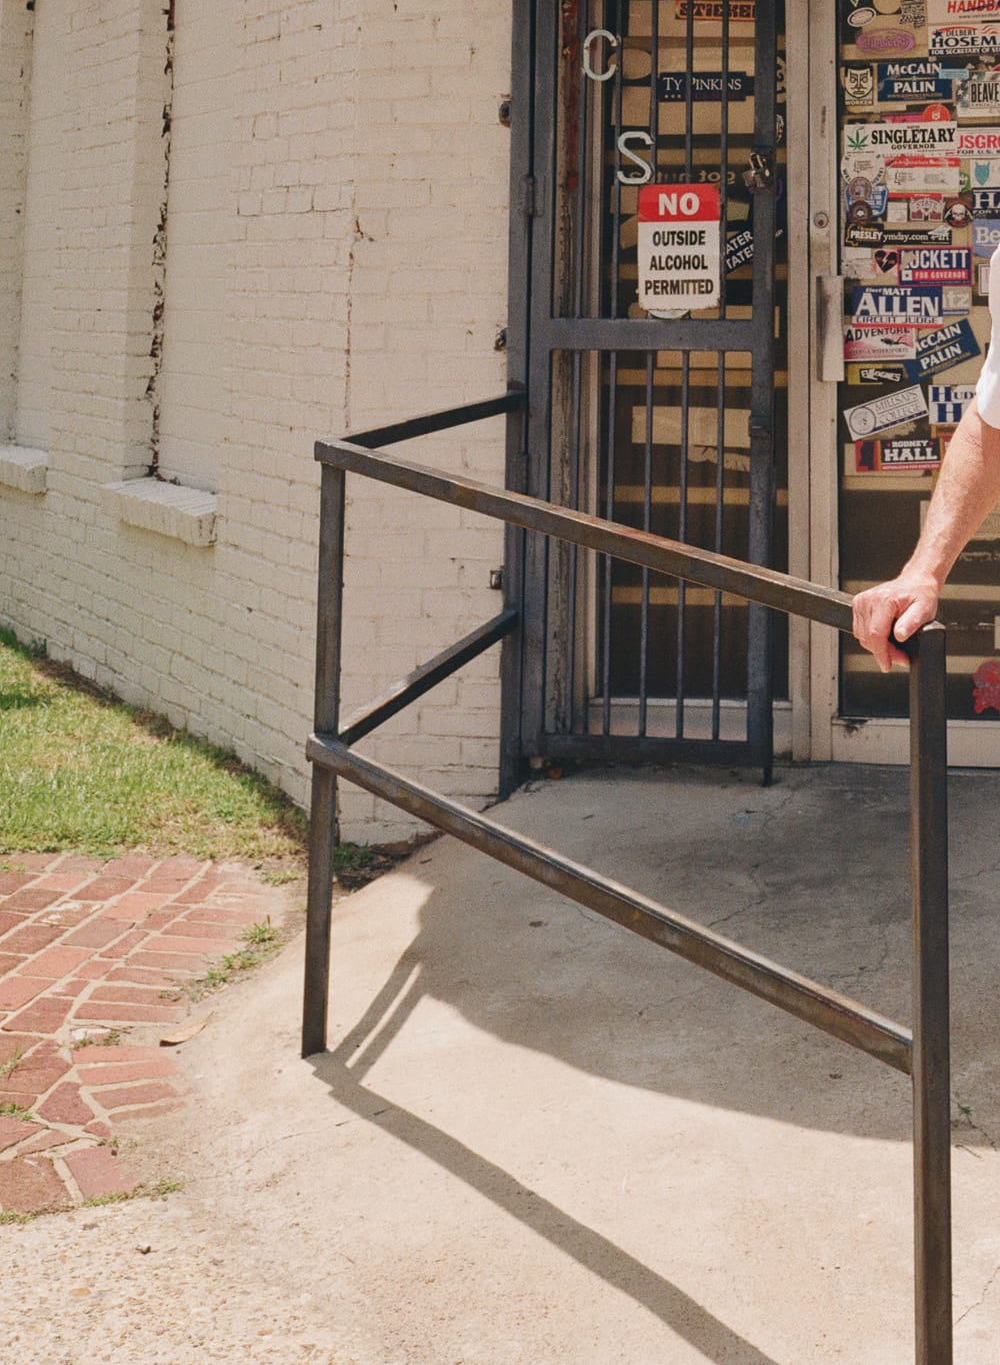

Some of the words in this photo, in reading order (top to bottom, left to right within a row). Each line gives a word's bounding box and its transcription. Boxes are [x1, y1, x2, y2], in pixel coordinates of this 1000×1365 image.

[584, 29, 618, 81] C
[946, 47, 980, 55] SECRETARY
[887, 63, 942, 75] McCAIN
[663, 77, 682, 90] TY
[894, 81, 936, 93] PALIN
[871, 127, 956, 145] SINGLETARY
[616, 131, 655, 184] S
[658, 192, 700, 216] NO
[652, 230, 706, 247] OUTSIDE
[850, 231, 883, 240] PRESLEY
[649, 254, 708, 271] ALCOHOL
[915, 271, 930, 279] FOR
[931, 270, 966, 279] GOVERNOR
[644, 278, 714, 295] PERMITTED
[882, 287, 912, 296] MATT
[855, 292, 940, 316] ALLEN
[856, 316, 896, 324] CIRCUIT
[904, 316, 937, 324] JUDGE
[844, 328, 911, 345] ADVENTURE
[920, 342, 962, 370] PALIN
[874, 390, 918, 412] MILLSAPS
[932, 386, 977, 402] HUD
[879, 404, 922, 424] COLLEGE
[884, 447, 938, 462] HALL
